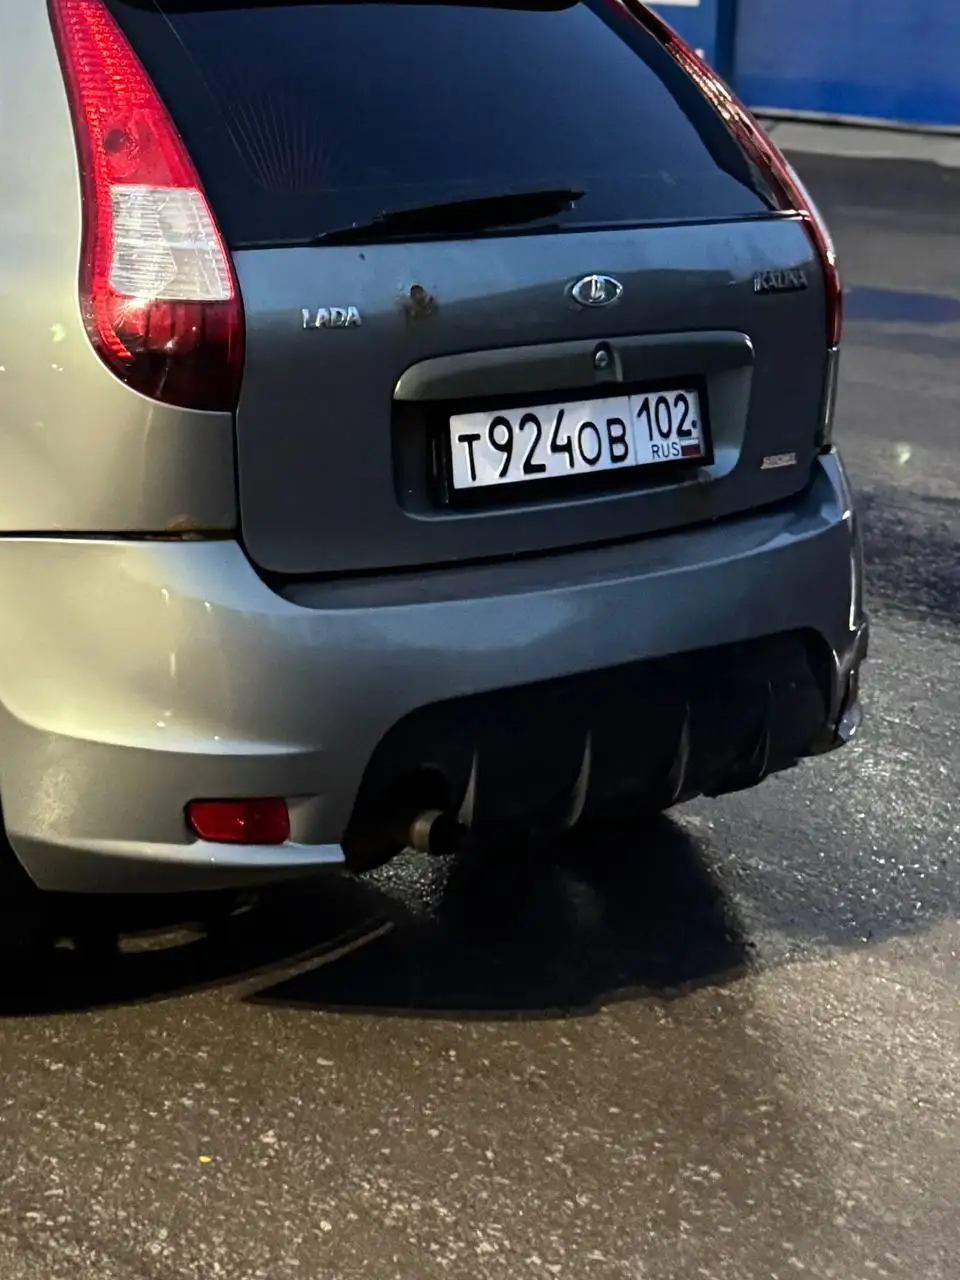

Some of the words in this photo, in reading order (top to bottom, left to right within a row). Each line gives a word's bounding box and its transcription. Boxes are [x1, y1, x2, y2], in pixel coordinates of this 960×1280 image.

[302, 306, 362, 328] LADA
[637, 393, 692, 441] 102
[652, 441, 681, 459] RUS
